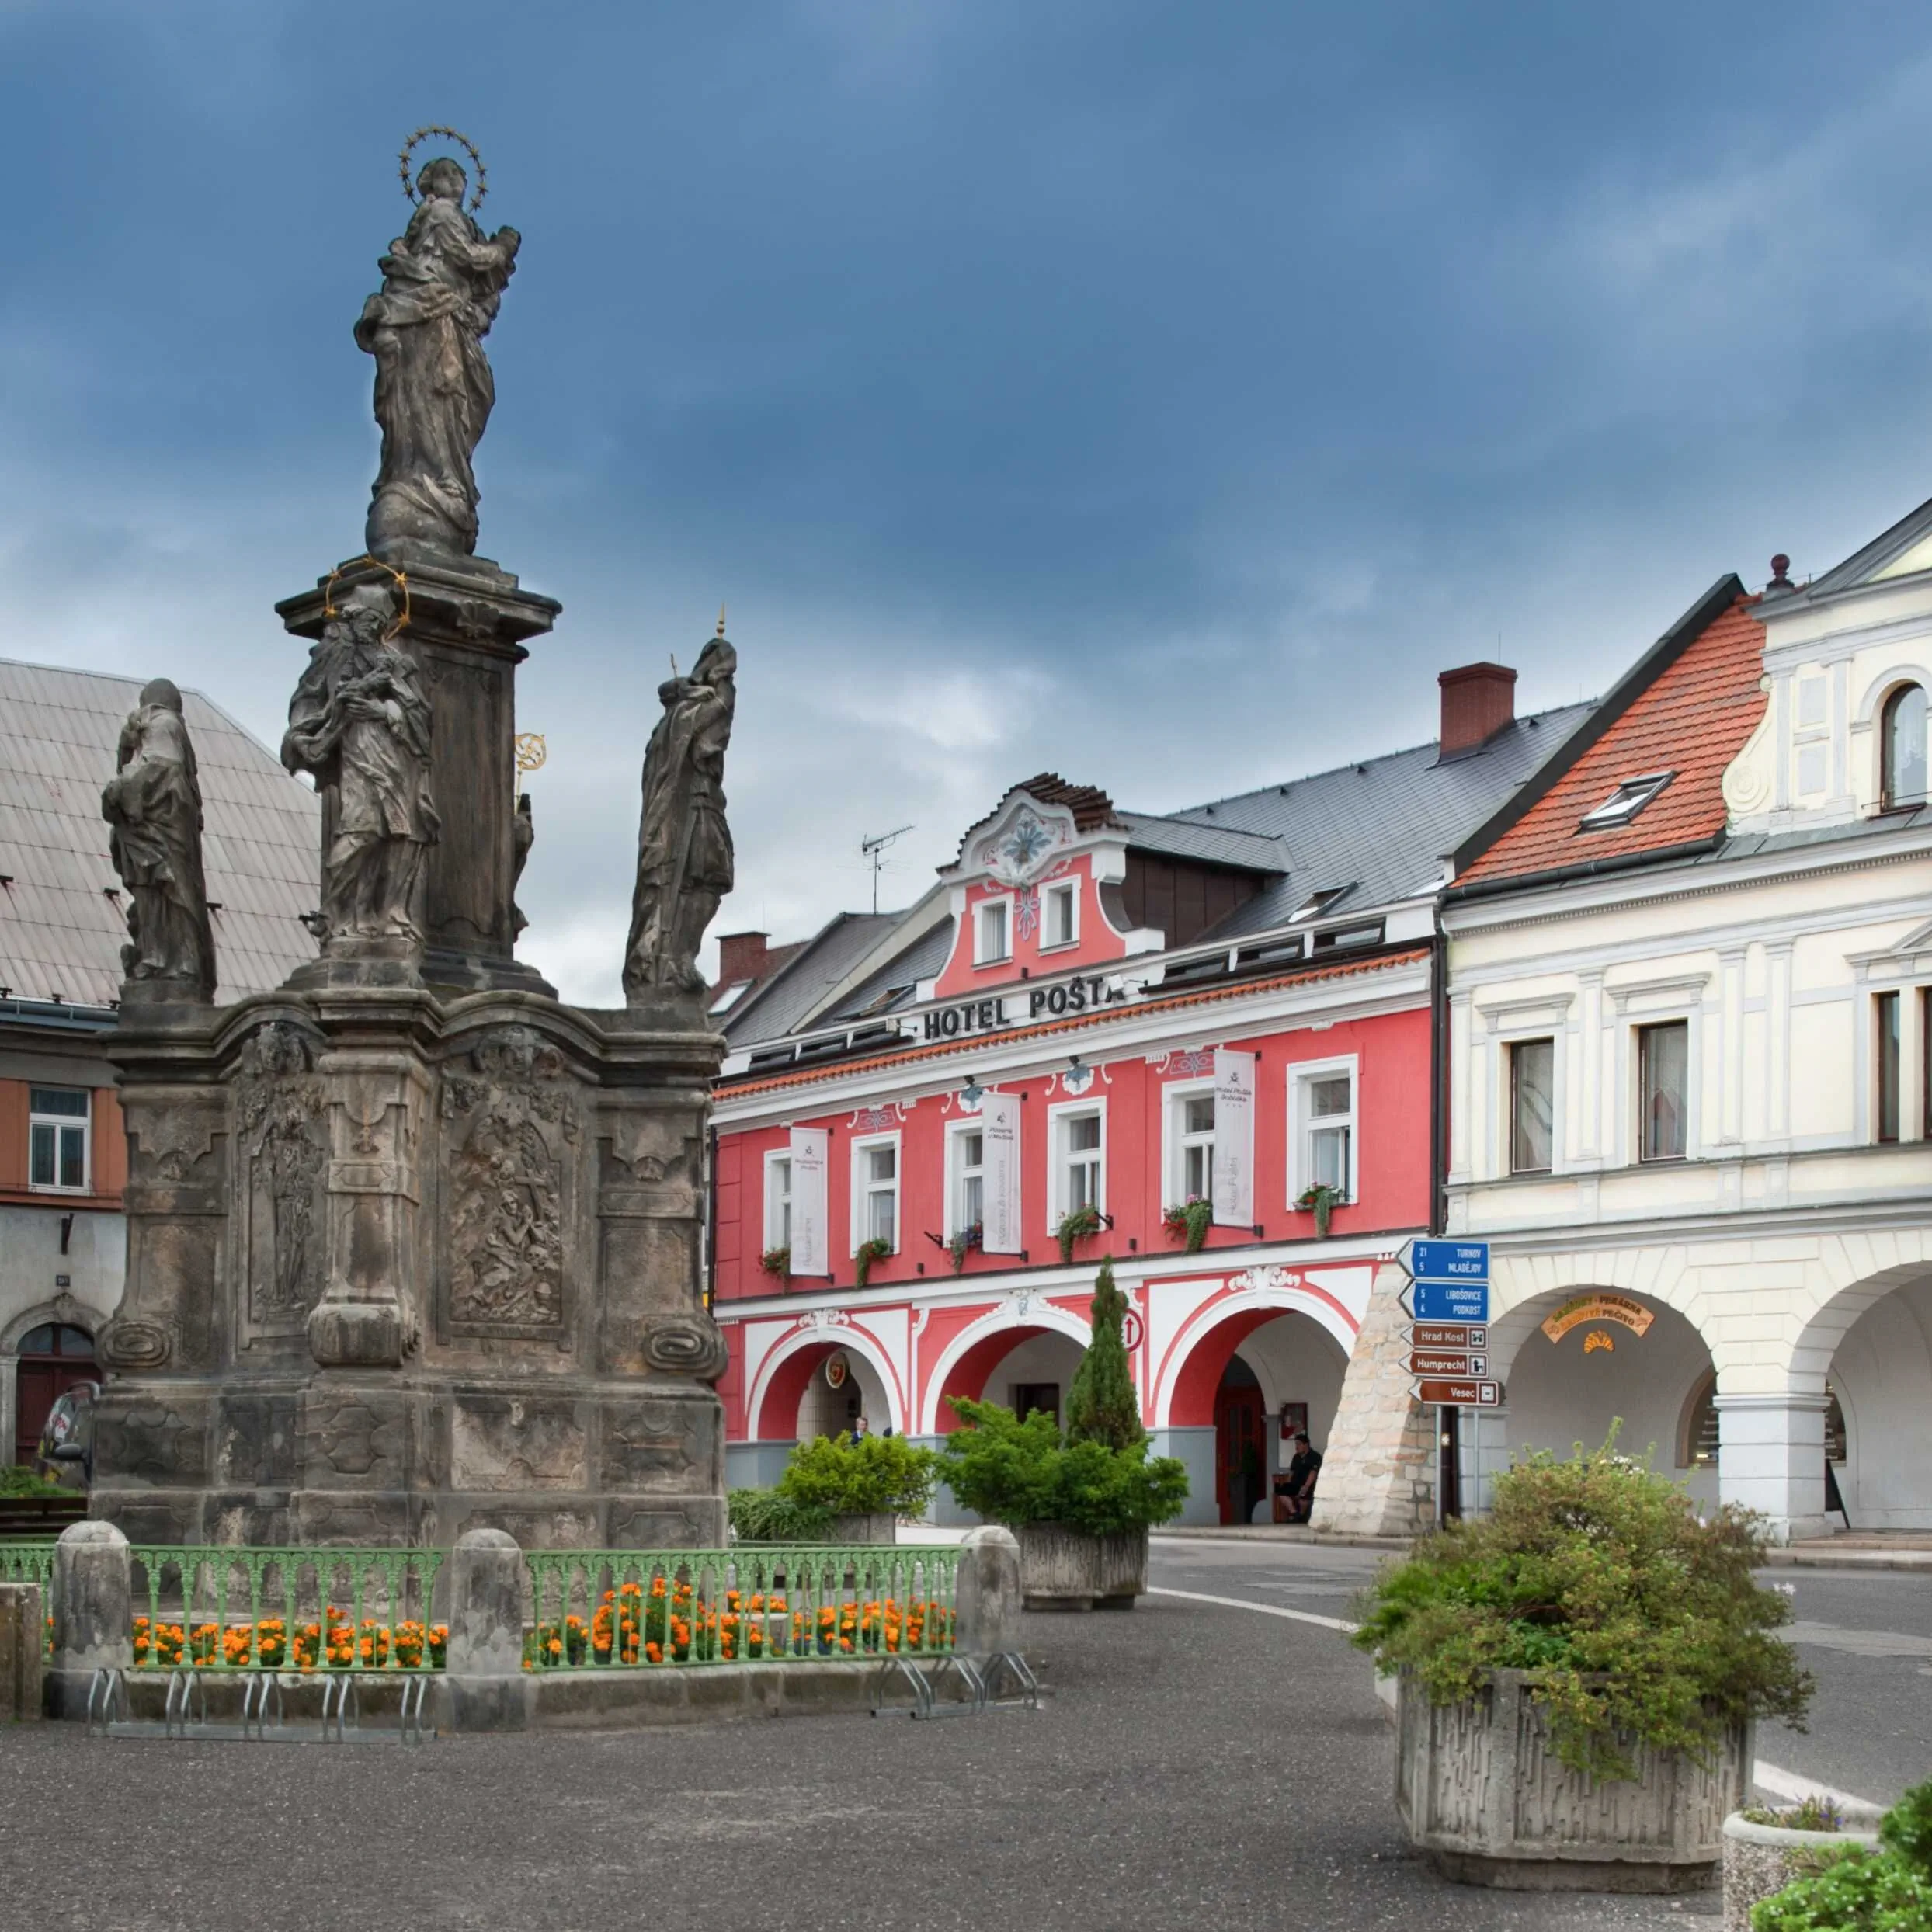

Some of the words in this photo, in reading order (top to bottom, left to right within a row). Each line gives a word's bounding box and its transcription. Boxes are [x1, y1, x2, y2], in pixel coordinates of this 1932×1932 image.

[924, 999, 1010, 1039] HOTEL
[1030, 976, 1124, 1018] POŠTA
[1419, 1247, 1427, 1257] 21
[1456, 1248, 1482, 1259] TURNOV
[1419, 1262, 1425, 1272] 5
[1420, 1288, 1426, 1298] 5
[1420, 1304, 1426, 1313] 4
[1421, 1330, 1442, 1341] Hrad
[1444, 1332, 1465, 1343] Kost
[1417, 1358, 1465, 1371] Humprecht
[1450, 1387, 1475, 1398] Vesec
